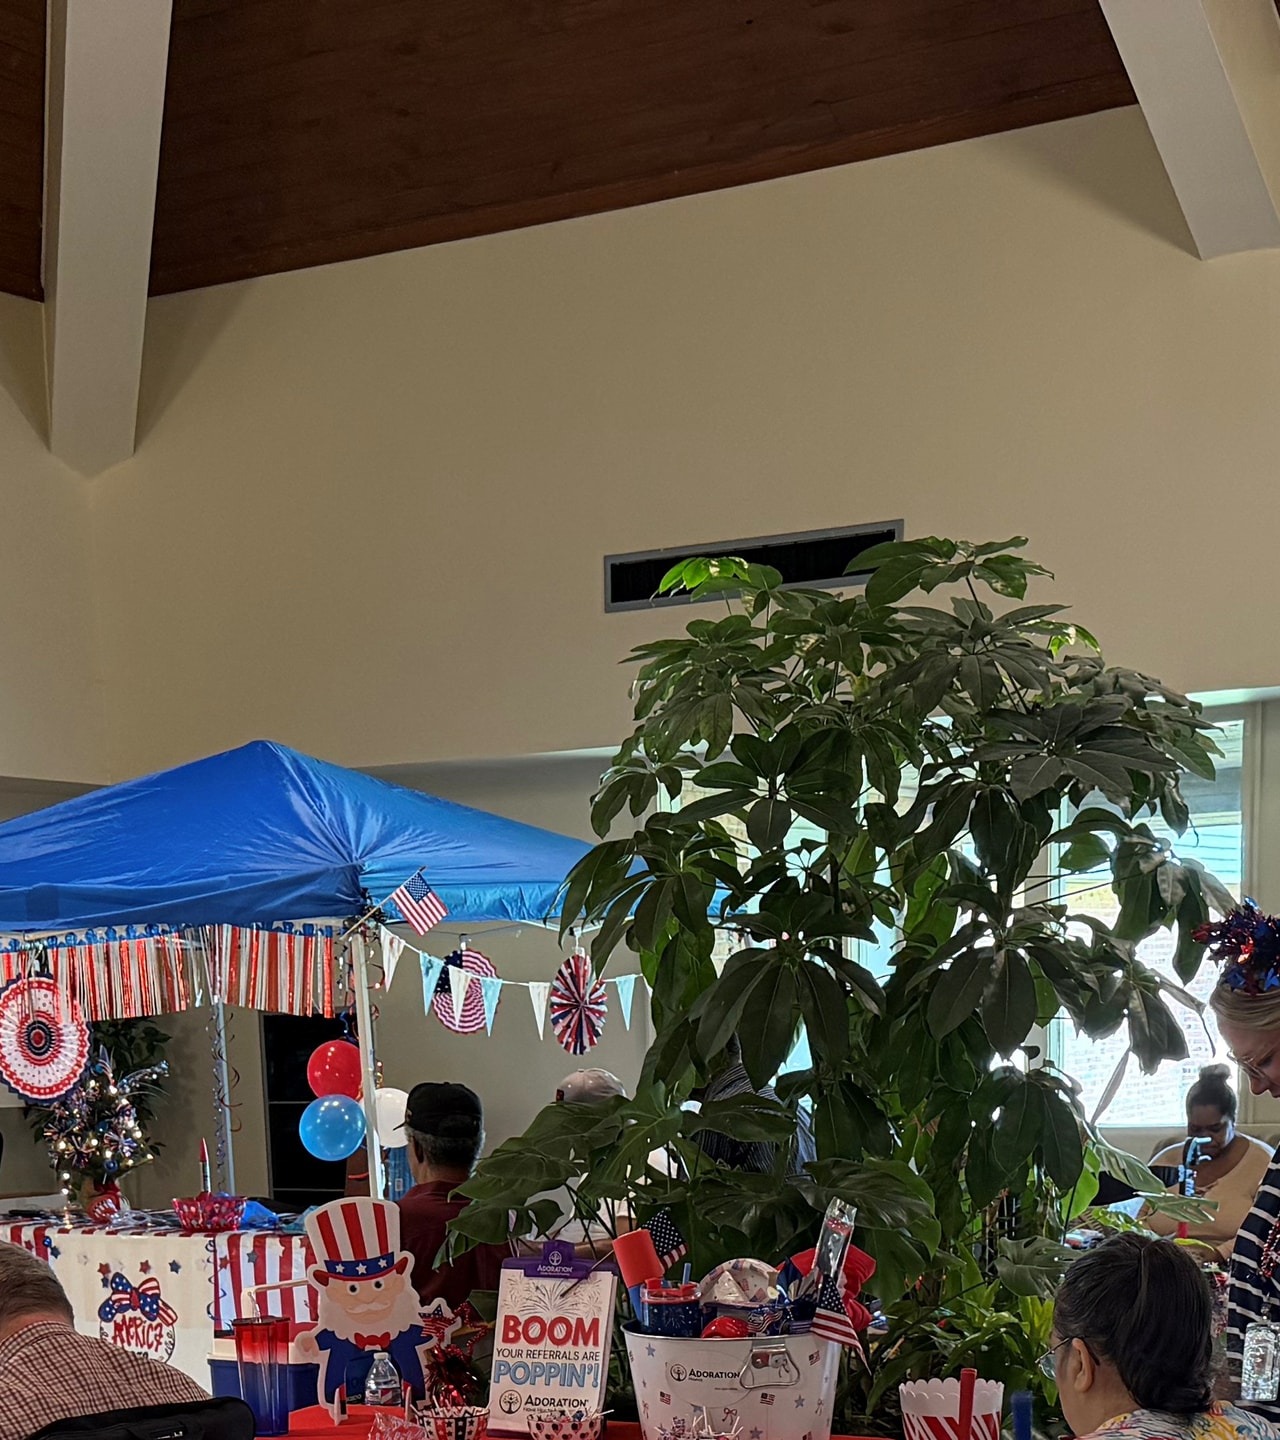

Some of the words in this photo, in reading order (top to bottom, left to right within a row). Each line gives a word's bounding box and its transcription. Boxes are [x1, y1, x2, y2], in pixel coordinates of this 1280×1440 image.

[502, 1315, 600, 1347] BOOM
[496, 1348, 523, 1359] YOUR
[526, 1350, 579, 1361] REFERRALS
[582, 1351, 600, 1361] ARE
[493, 1360, 600, 1388] POPPIN'!
[688, 1368, 740, 1379] ADORATION
[524, 1394, 587, 1408] ADORATION
